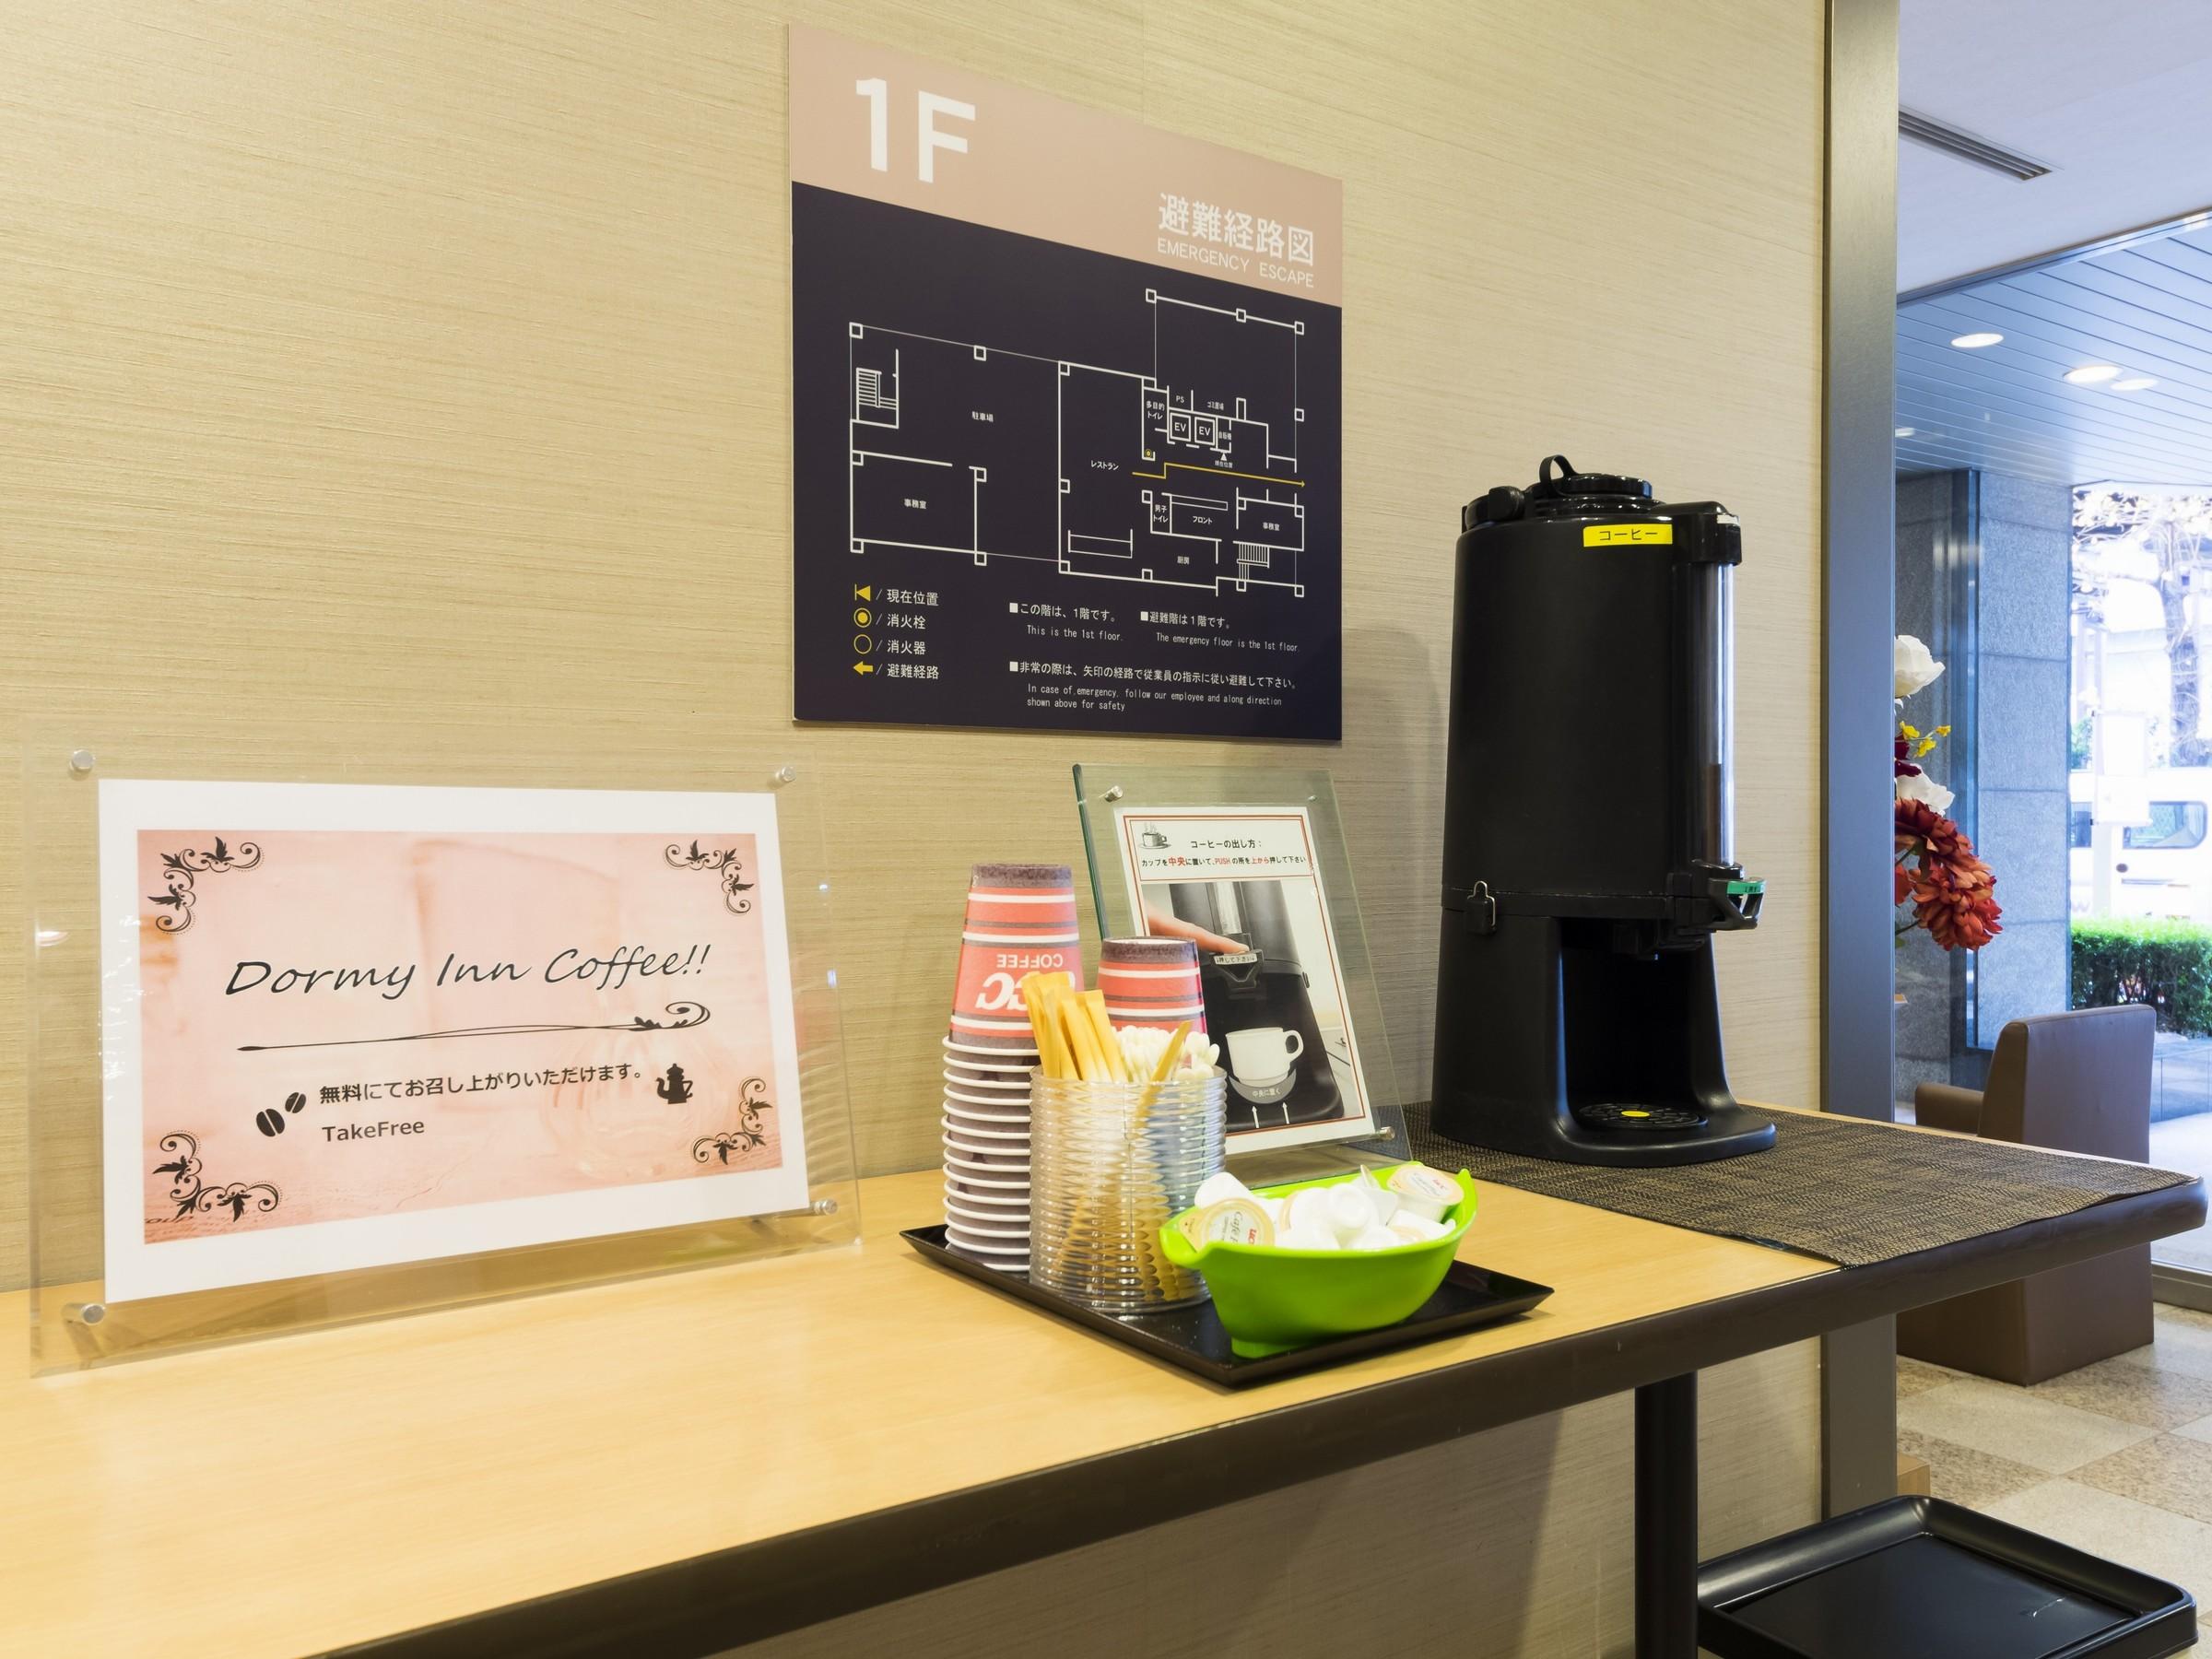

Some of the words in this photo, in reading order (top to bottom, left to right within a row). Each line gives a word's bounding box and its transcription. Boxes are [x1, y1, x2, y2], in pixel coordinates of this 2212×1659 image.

[855, 76, 976, 183] 1F
[1158, 193, 1314, 267] 避難経路図
[1157, 237, 1250, 274] EMERGENCY
[1259, 262, 1314, 288] ESCAPE
[1175, 394, 1185, 404] PS
[1147, 411, 1164, 420] トイレ
[1174, 422, 1187, 432] EV
[1198, 426, 1211, 436] EV
[1090, 459, 1120, 471] レストラン
[1152, 514, 1169, 524] トイレ
[1192, 515, 1213, 525] フロント
[1599, 528, 1658, 541] コーヒー
[887, 589, 939, 606] 現在位置
[887, 613, 926, 629] 消火栓
[1027, 624, 1046, 636] This
[1051, 626, 1060, 637] is
[1064, 628, 1077, 638] the
[1081, 629, 1095, 640] 1st
[887, 639, 927, 655] 消火器
[1156, 631, 1170, 642] The
[1172, 634, 1210, 647] emergency
[1213, 636, 1233, 647] floor
[1237, 639, 1245, 649] is
[1249, 640, 1261, 650] the
[1265, 641, 1276, 651] 1st
[887, 663, 940, 680] 避難経路
[1028, 683, 1037, 693] In
[1041, 686, 1060, 695] case
[1063, 685, 1073, 695] of
[1125, 688, 1151, 700] follow
[1154, 690, 1167, 700] our
[1171, 691, 1205, 703] employee
[1207, 693, 1220, 703] and
[1223, 694, 1244, 705] along
[1246, 694, 1282, 707] direction
[1027, 697, 1051, 708] shown
[1053, 698, 1077, 709] above
[1082, 699, 1094, 710] for
[1099, 700, 1125, 712] safety
[996, 953, 1064, 969] COFFEE
[225, 959, 418, 1001] Dormy
[435, 952, 532, 987] Inn
[544, 943, 712, 991] Coffee!!
[318, 1062, 644, 1106] 無料にてお召し上がりいただけます。
[321, 1118, 427, 1143] TakeFree
